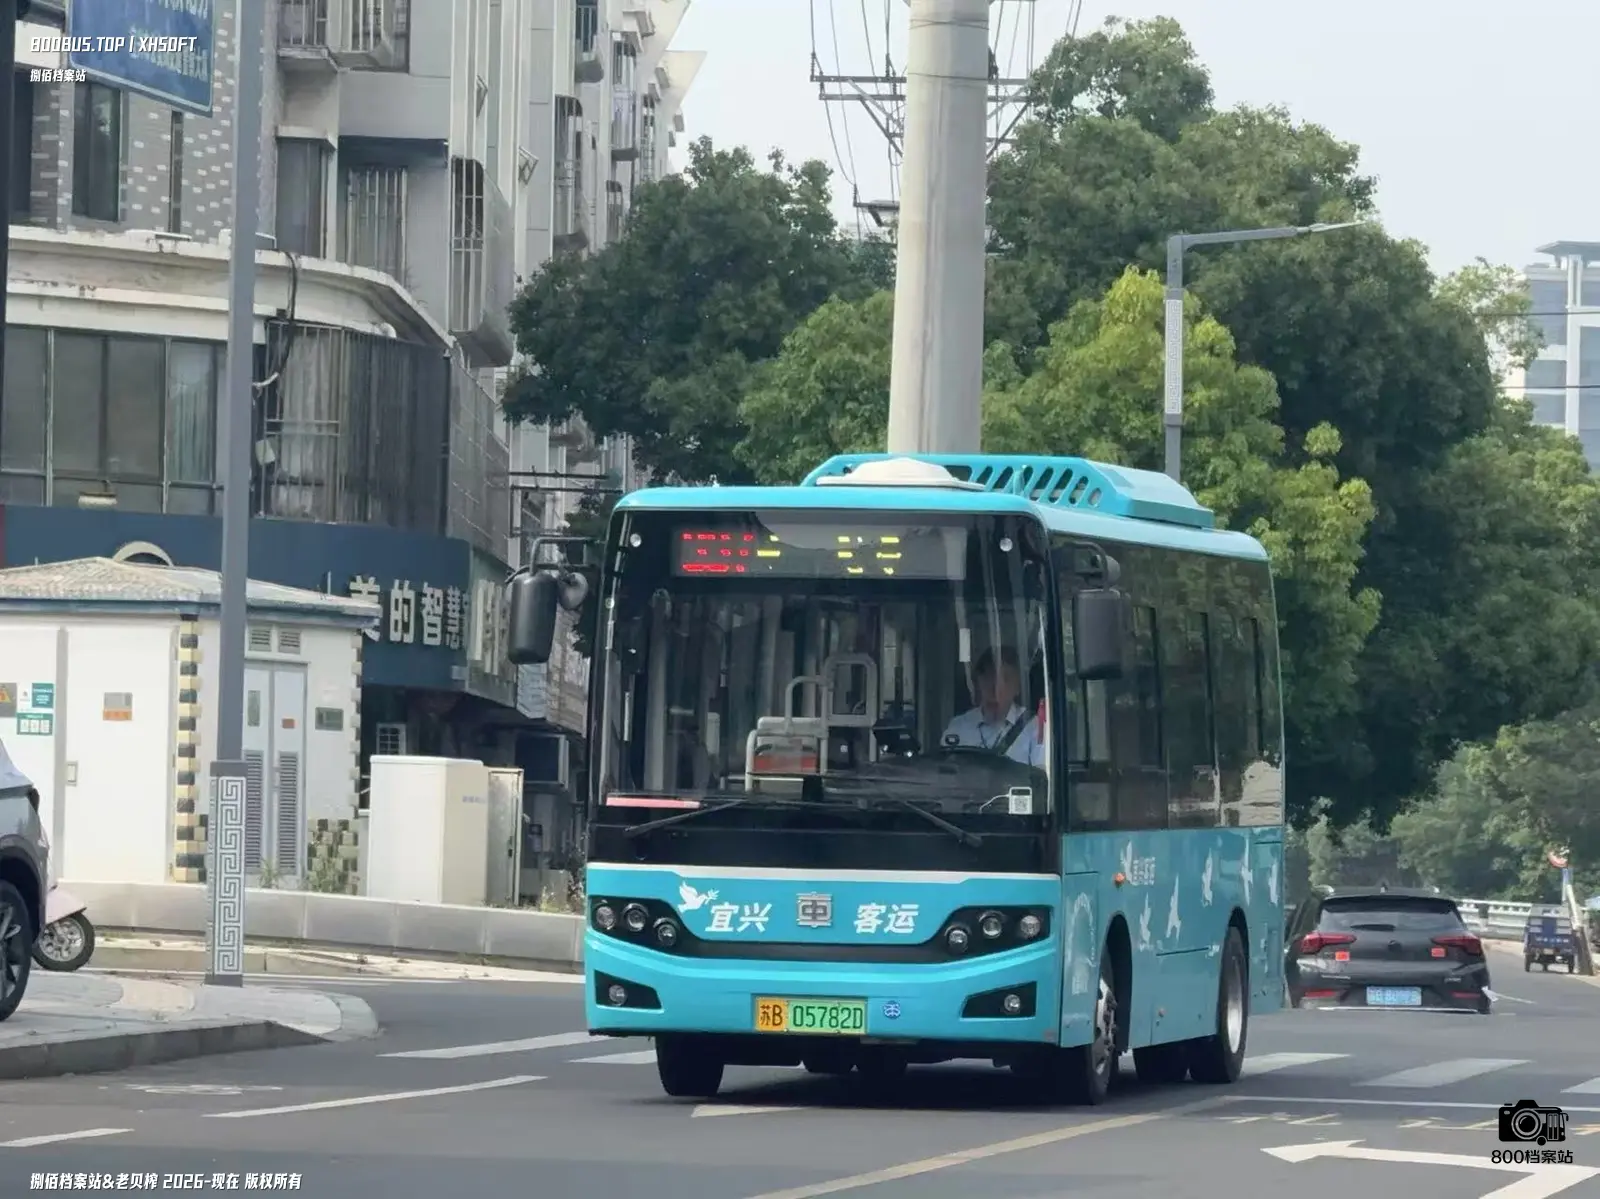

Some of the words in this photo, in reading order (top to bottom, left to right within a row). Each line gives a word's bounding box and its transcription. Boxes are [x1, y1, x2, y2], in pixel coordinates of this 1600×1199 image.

[705, 902, 772, 933] 宜兴
[854, 903, 919, 934] 客运
[760, 1004, 783, 1026] 苏B
[793, 1005, 863, 1029] 05782D
